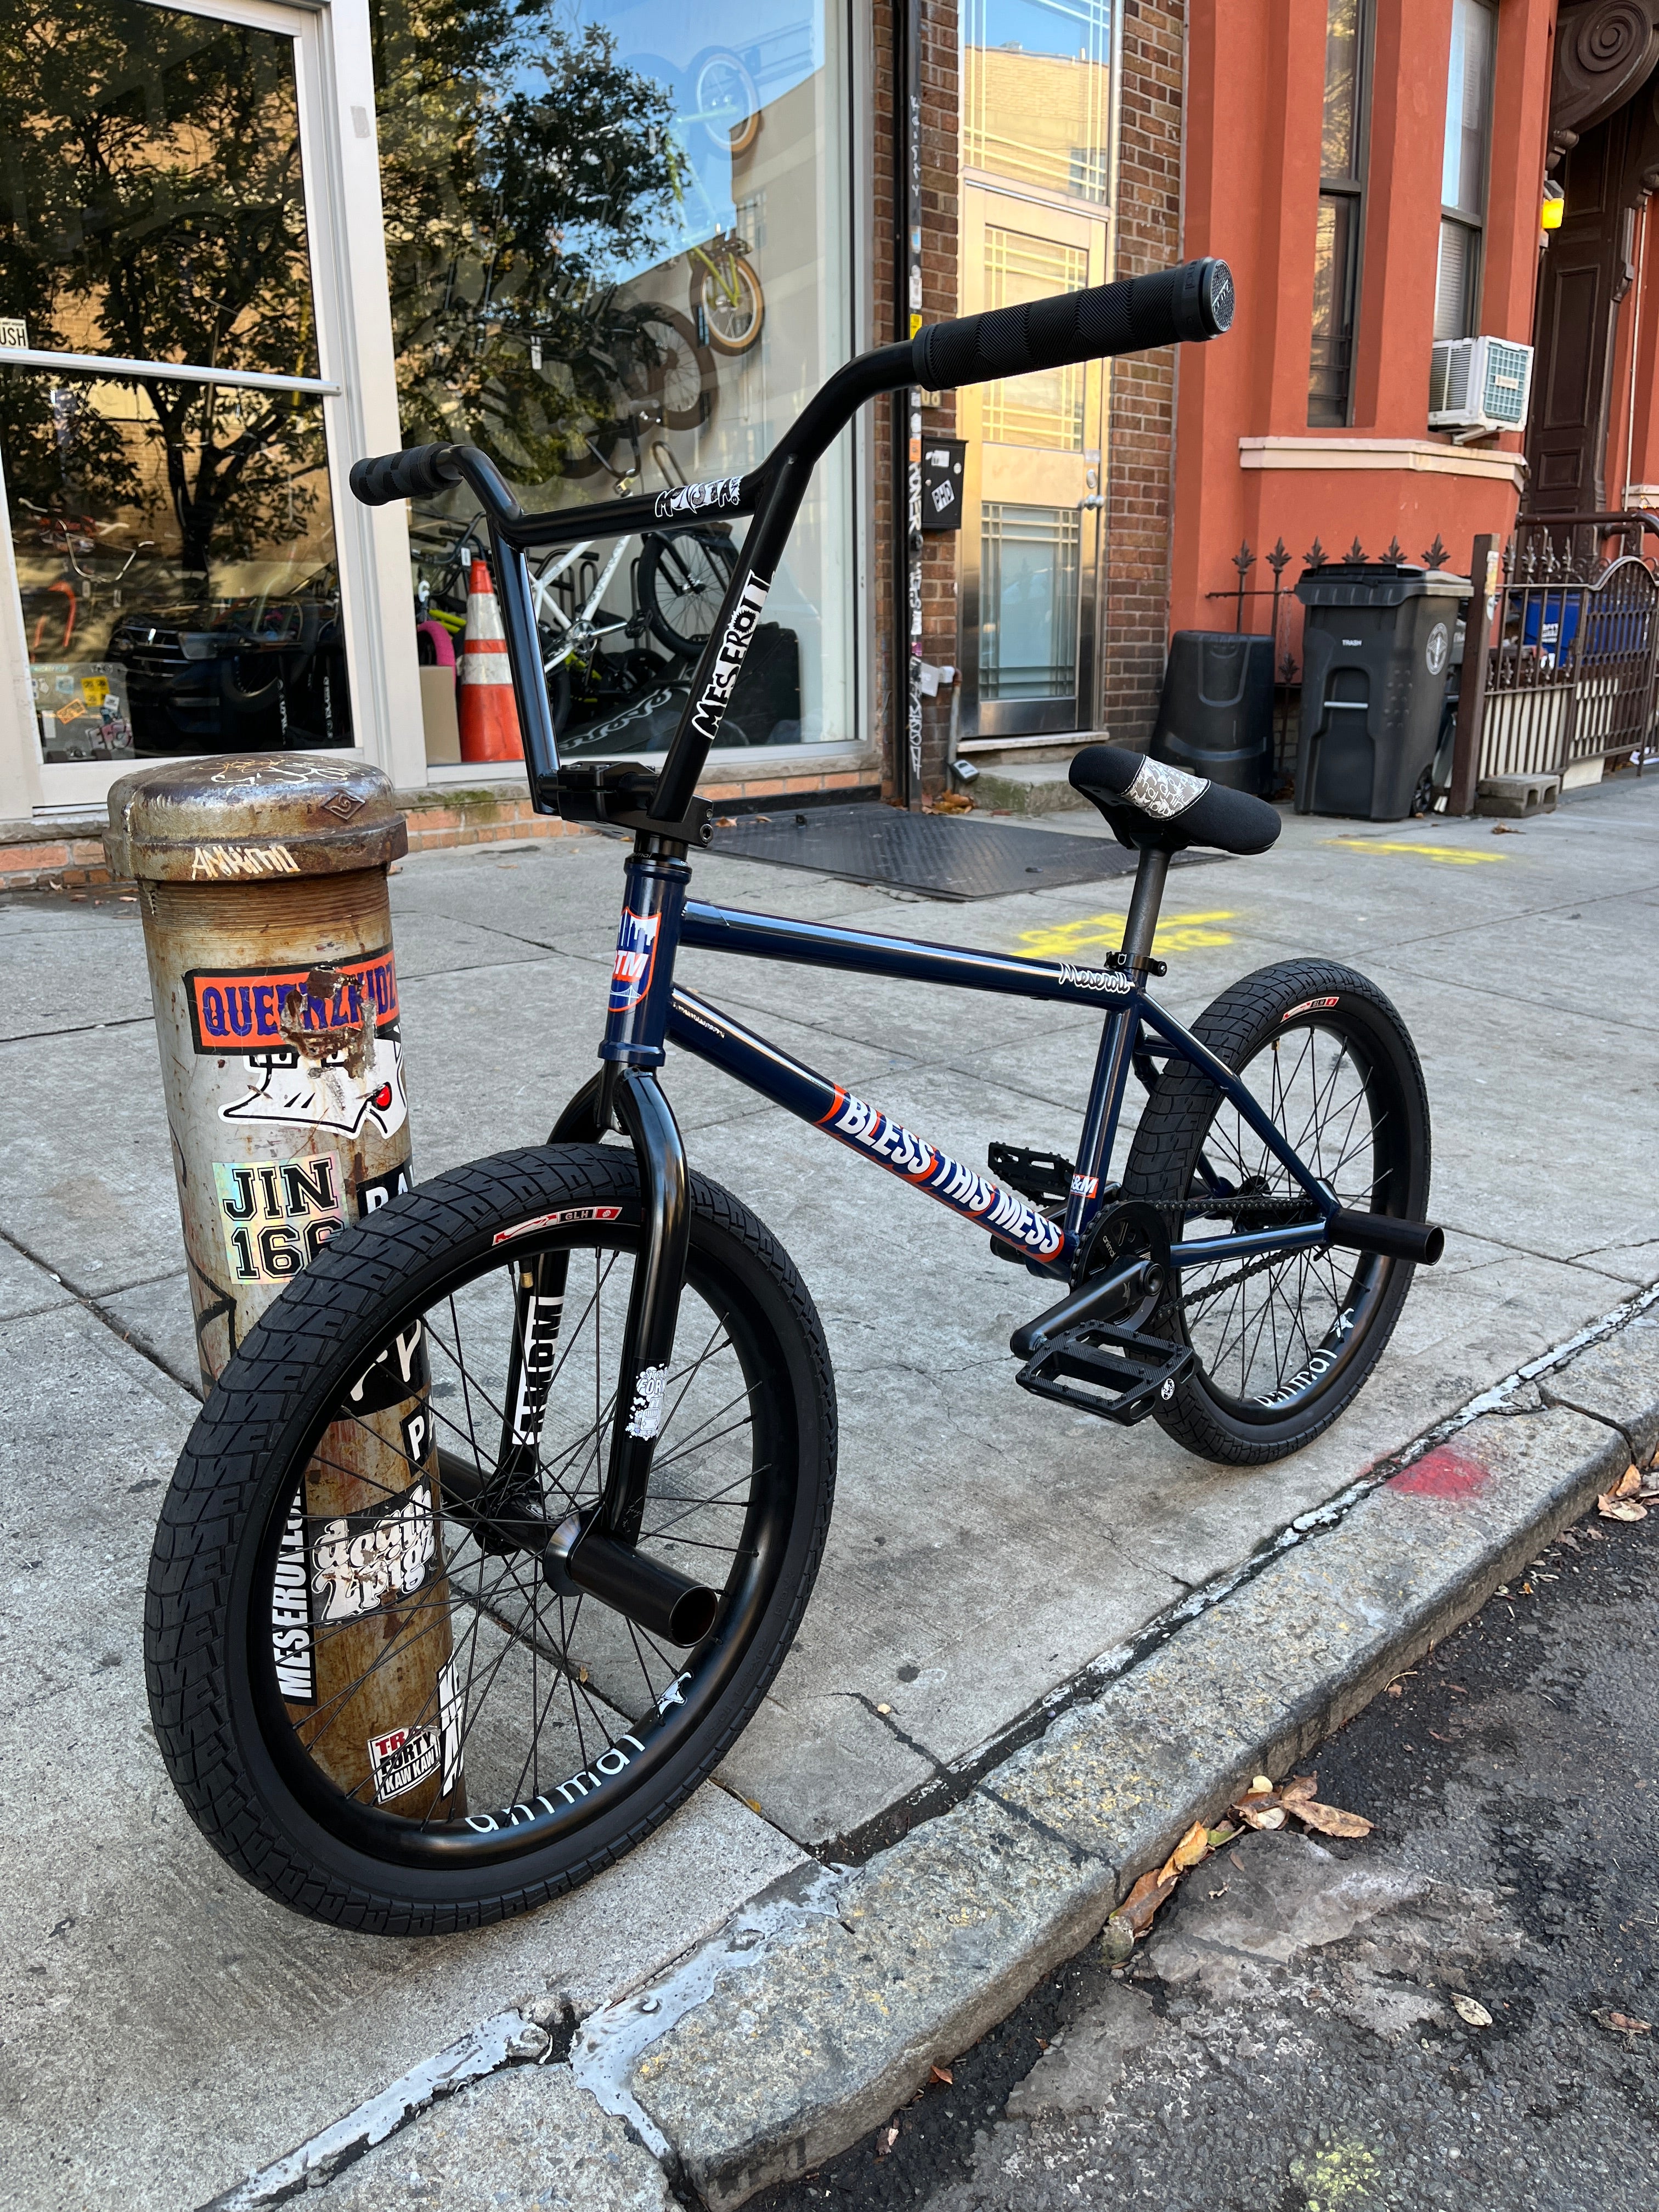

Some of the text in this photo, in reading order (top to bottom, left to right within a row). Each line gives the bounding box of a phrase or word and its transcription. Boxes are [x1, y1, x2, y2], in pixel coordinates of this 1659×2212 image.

[614, 950, 650, 978] TM
[223, 1157, 339, 1221] JIN
[835, 1093, 1062, 1254] BLESS THIS MESS
[565, 1210, 589, 1220] GLH
[1103, 1235, 1116, 1258] animal
[379, 1731, 431, 1775] FORTY
[385, 1748, 435, 1793] KAW KAW
[465, 1734, 645, 1833] animal
